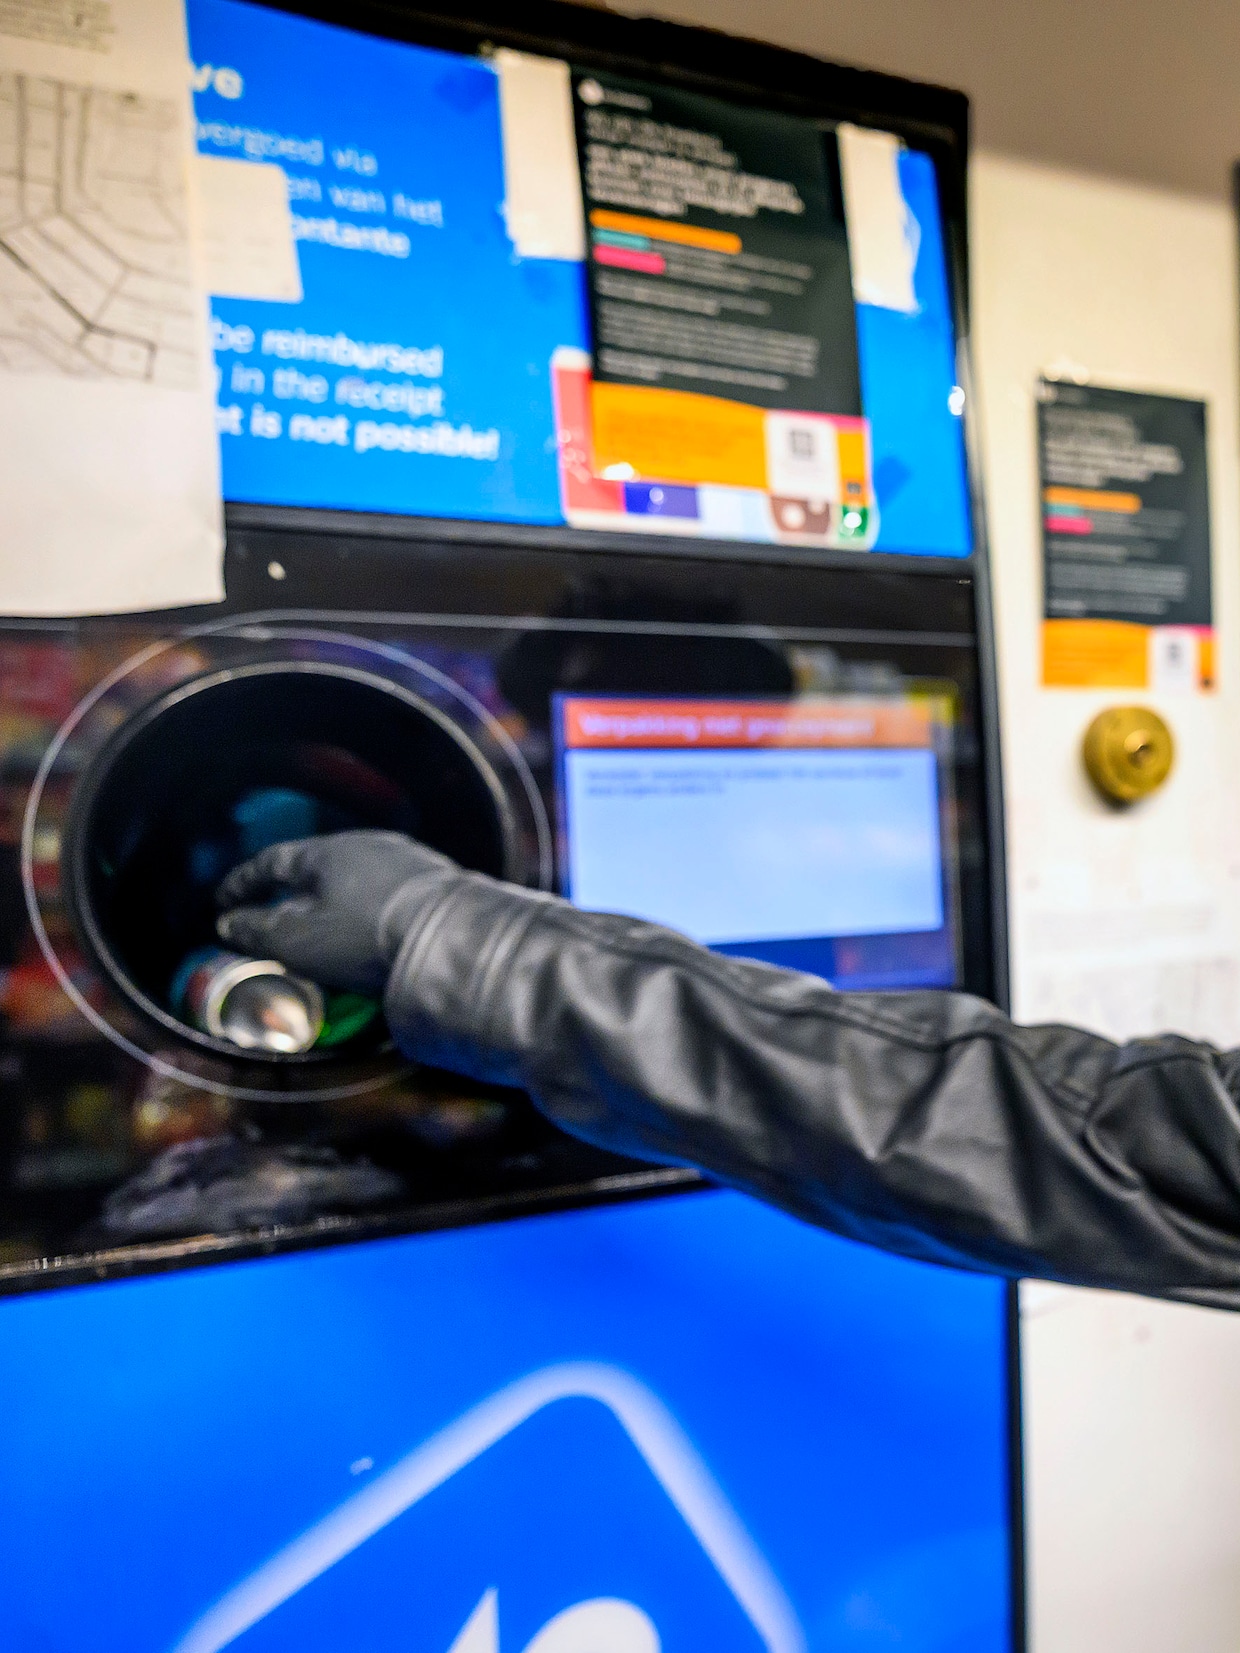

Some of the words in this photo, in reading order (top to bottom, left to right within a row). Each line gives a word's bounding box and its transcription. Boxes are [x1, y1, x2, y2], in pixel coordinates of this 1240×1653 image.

[331, 146, 379, 177] via
[329, 184, 386, 213] van
[261, 327, 444, 378] reimbursed
[230, 361, 265, 395] in
[272, 366, 329, 404] the
[335, 374, 444, 419] receipt
[250, 402, 282, 439] is
[288, 413, 350, 446] not
[354, 420, 500, 461] possible!
